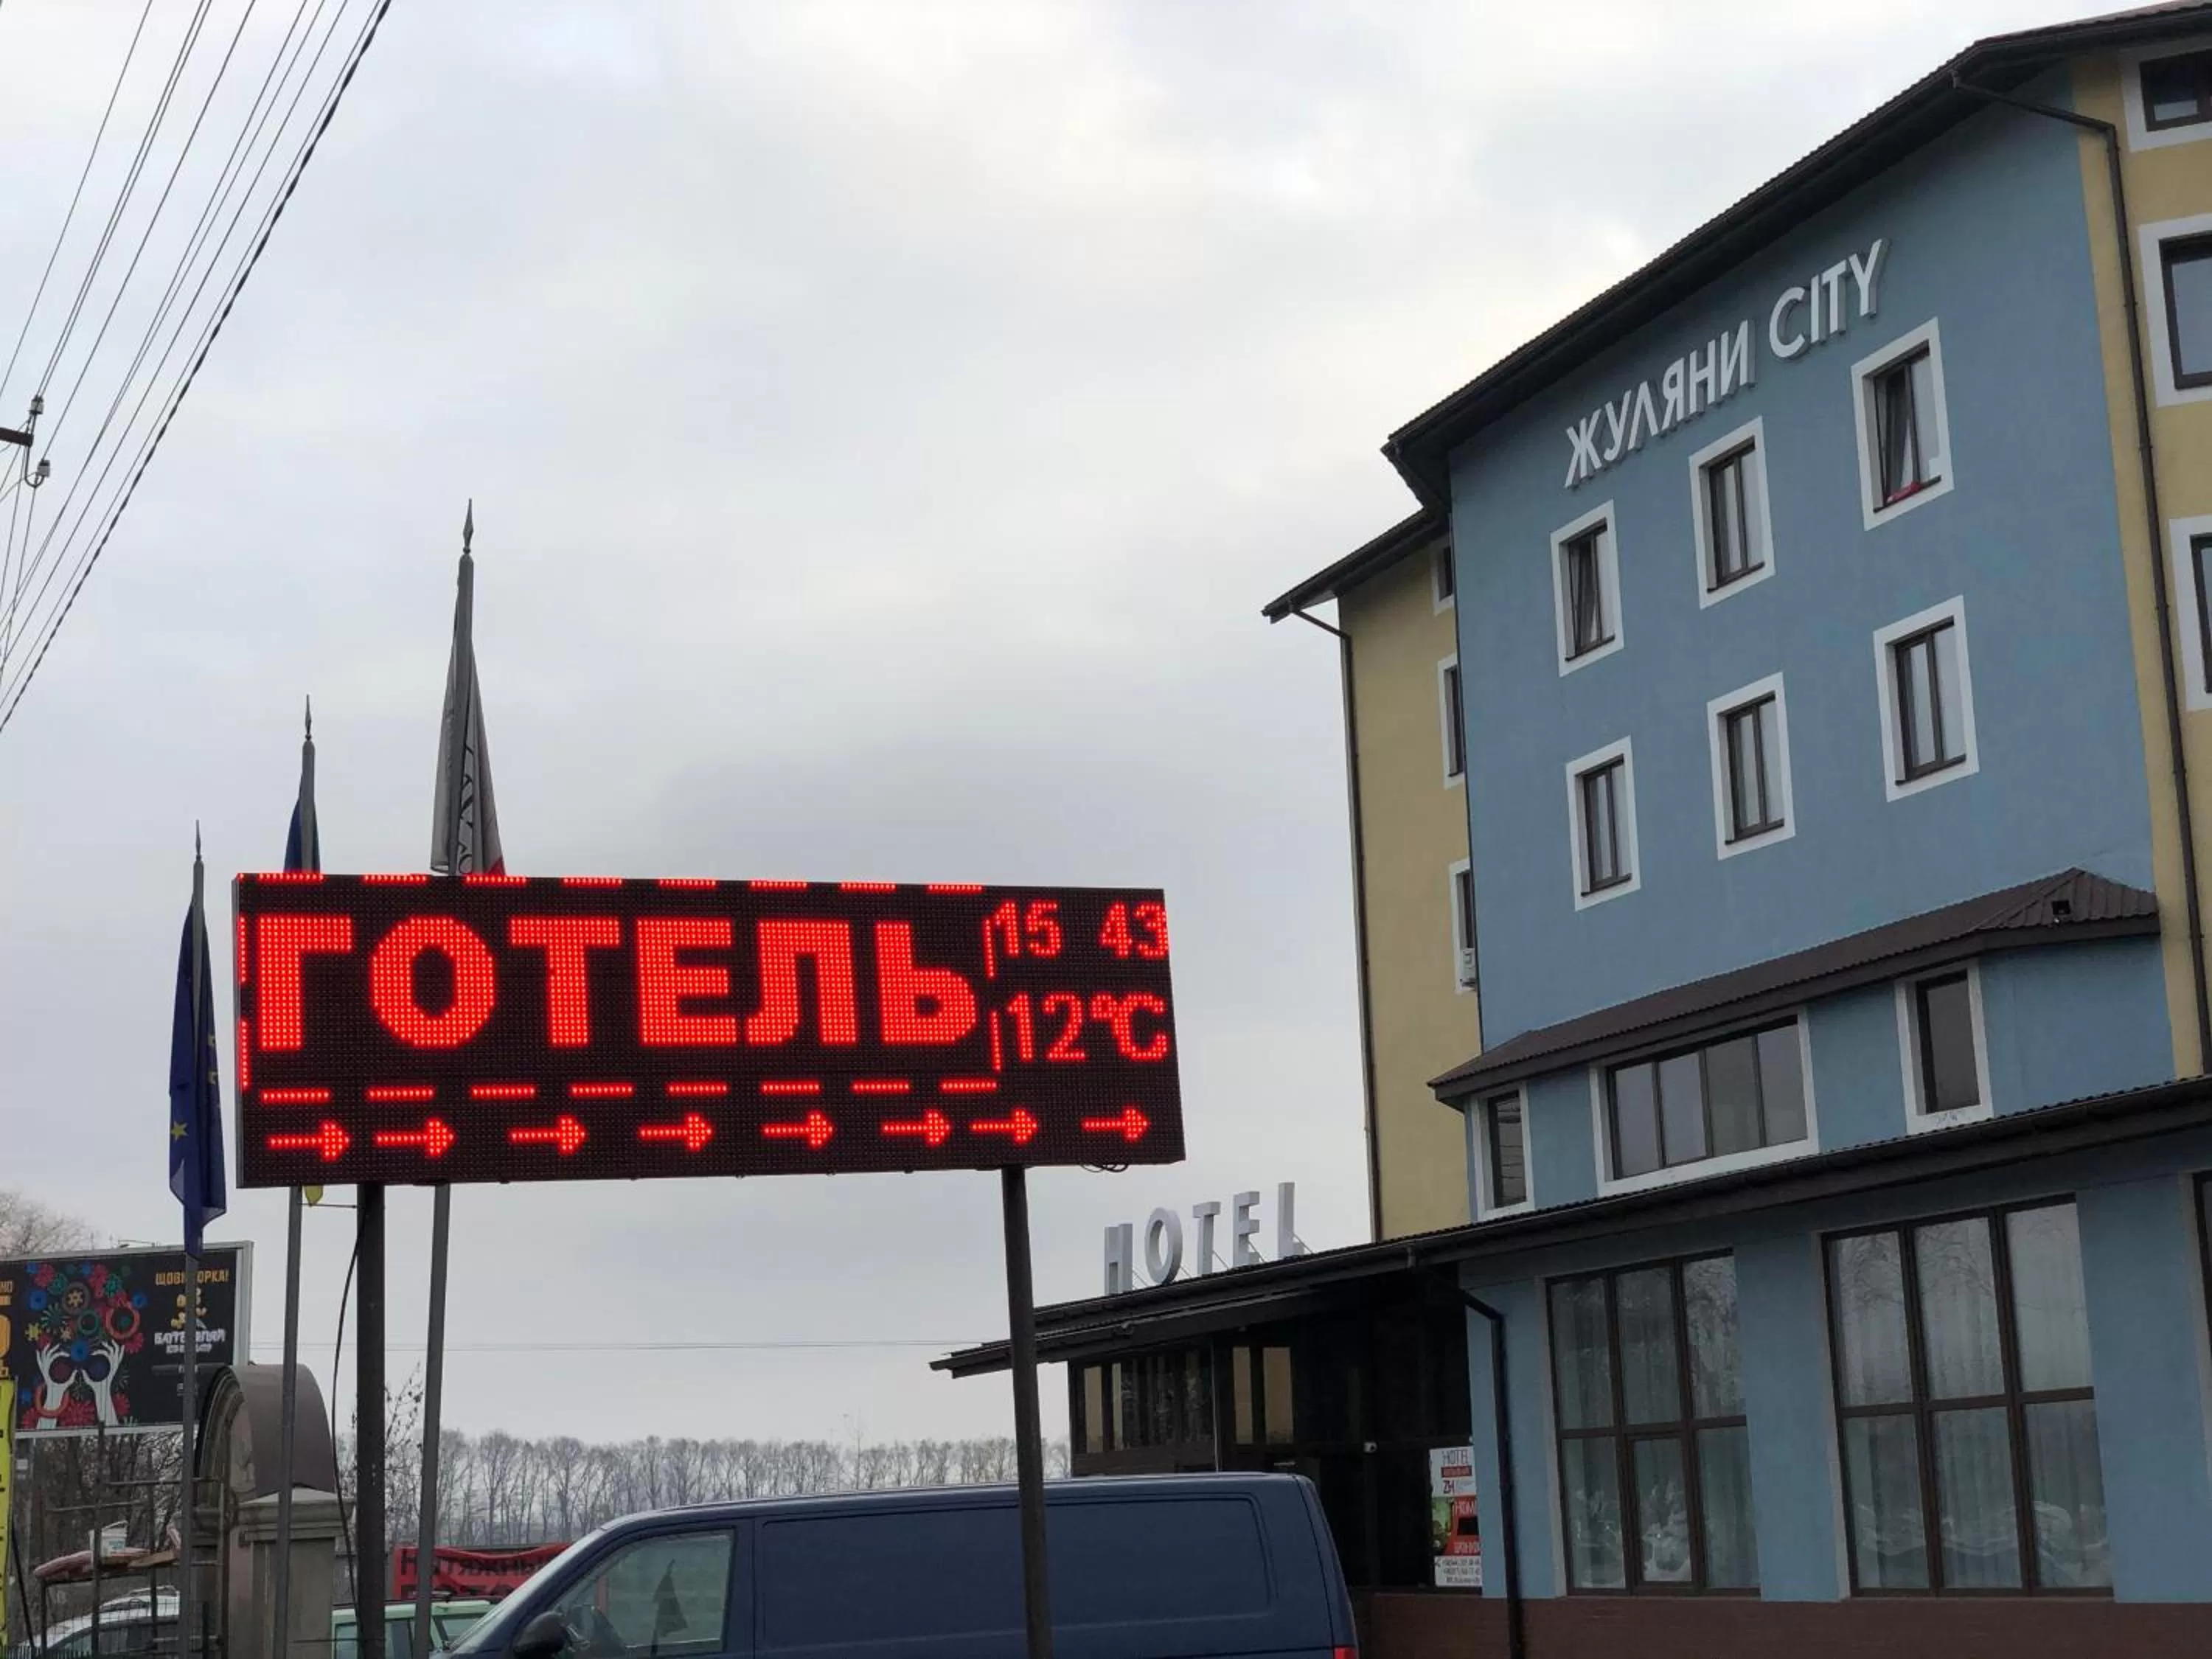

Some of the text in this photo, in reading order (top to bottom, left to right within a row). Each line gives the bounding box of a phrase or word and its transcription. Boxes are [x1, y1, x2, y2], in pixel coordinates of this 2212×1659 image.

[1565, 237, 1891, 490] ЖУЛЯНИ CITY
[258, 914, 978, 1051] ГОТЕЛЬ
[995, 900, 1169, 959] 15 43
[156, 1268, 230, 1285] ЩОВІОРКА!
[1104, 1181, 1304, 1295] HOTEL
